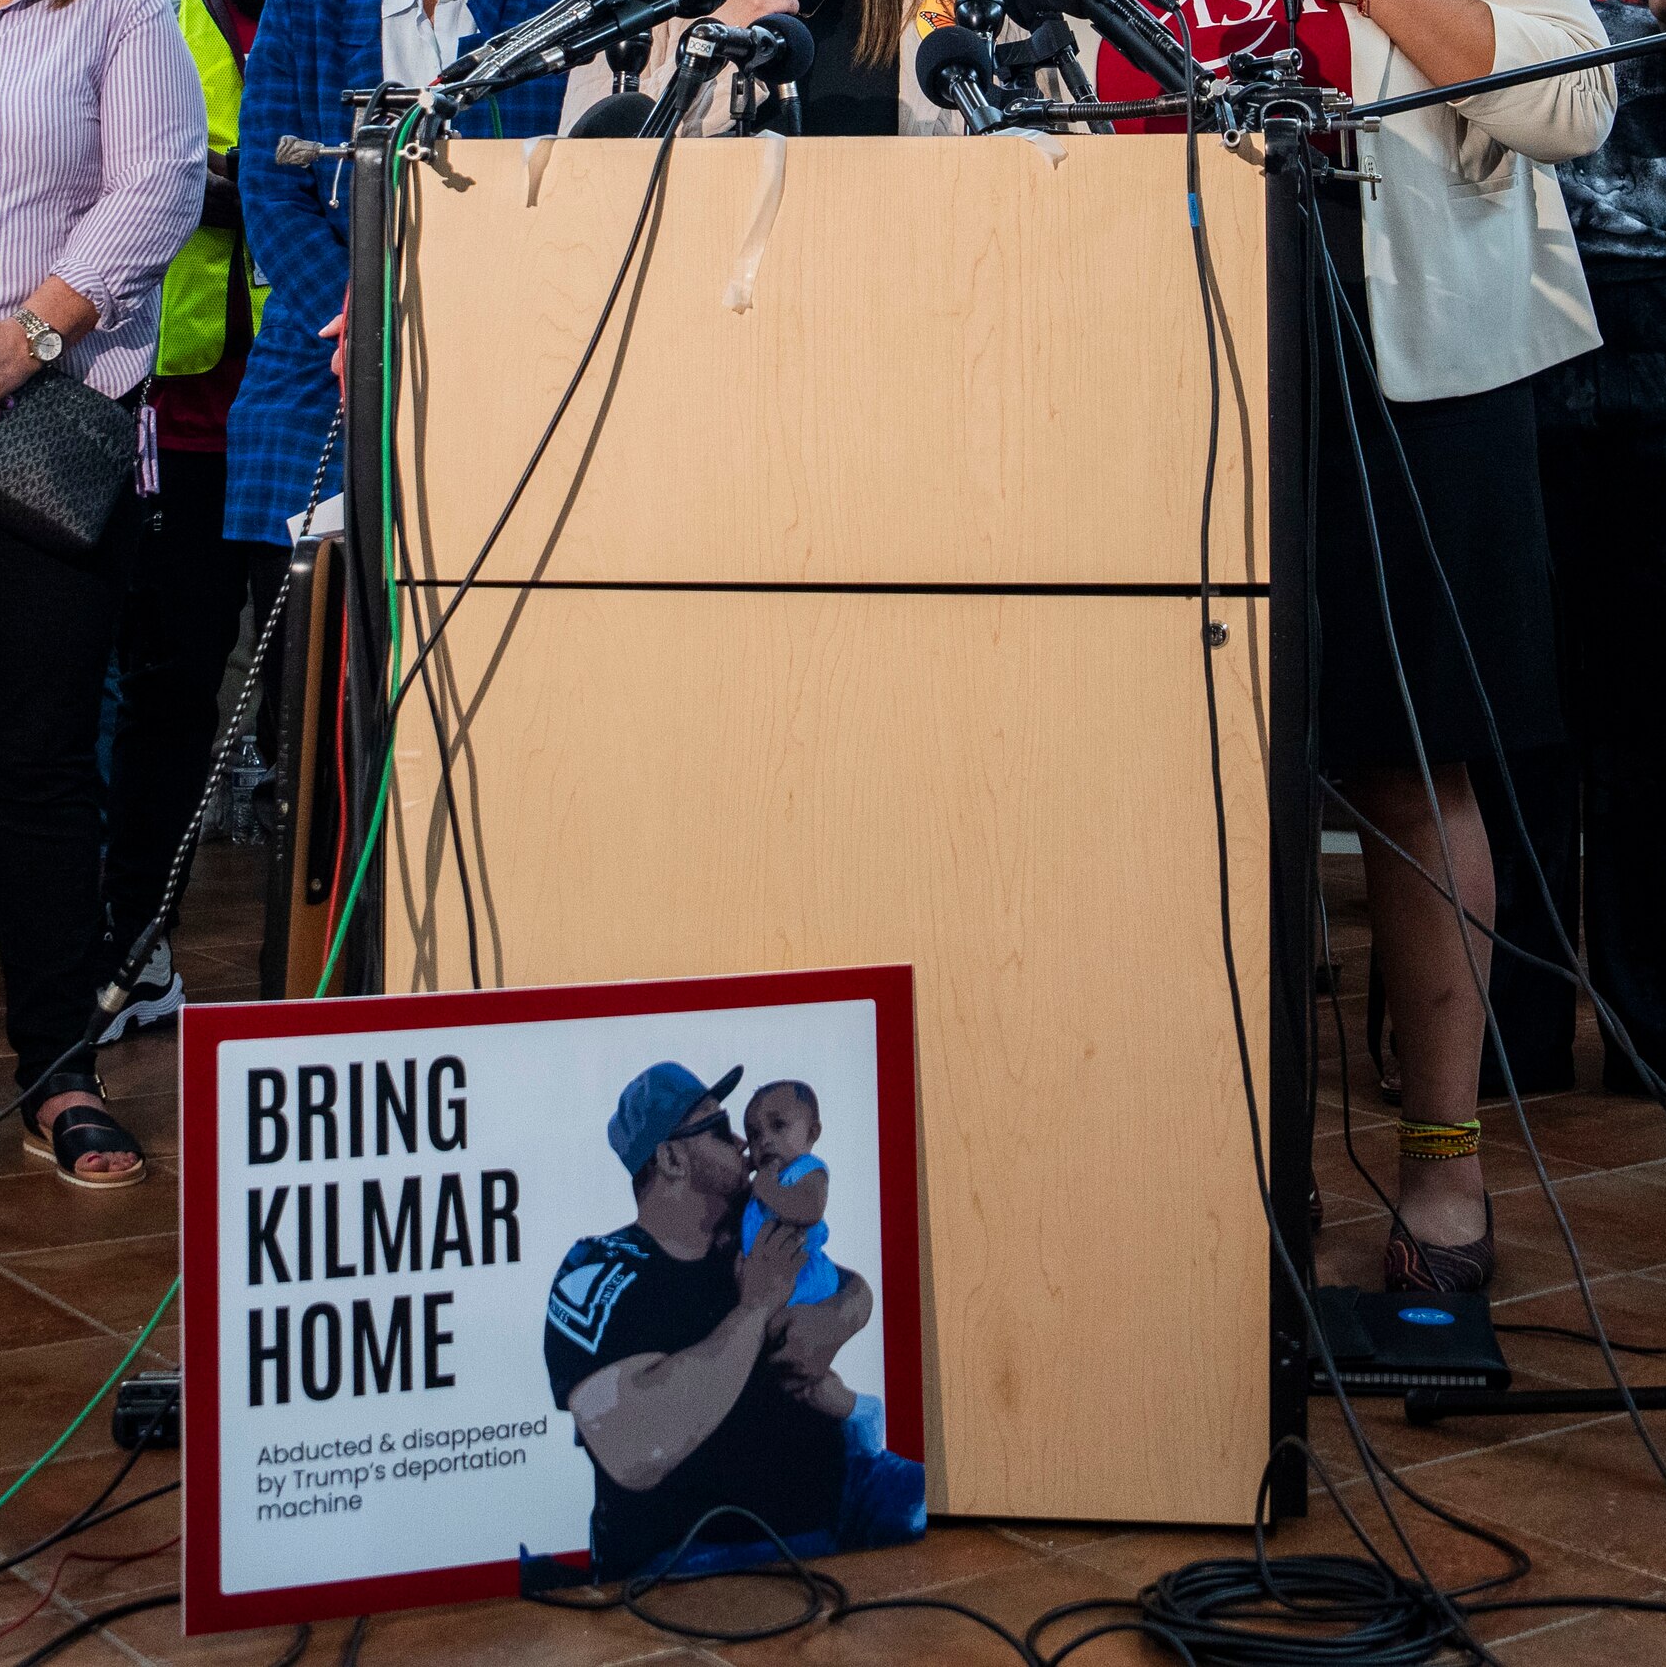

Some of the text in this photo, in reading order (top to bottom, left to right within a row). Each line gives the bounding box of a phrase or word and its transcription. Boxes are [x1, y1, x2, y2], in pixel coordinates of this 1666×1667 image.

[248, 1054, 468, 1165] BRING
[248, 1168, 521, 1286] KILMAR
[249, 1291, 456, 1407] HOME
[257, 1415, 548, 1466] Abducted & disappeared
[257, 1448, 527, 1497] by Trump's deportation
[257, 1494, 364, 1521] machine
